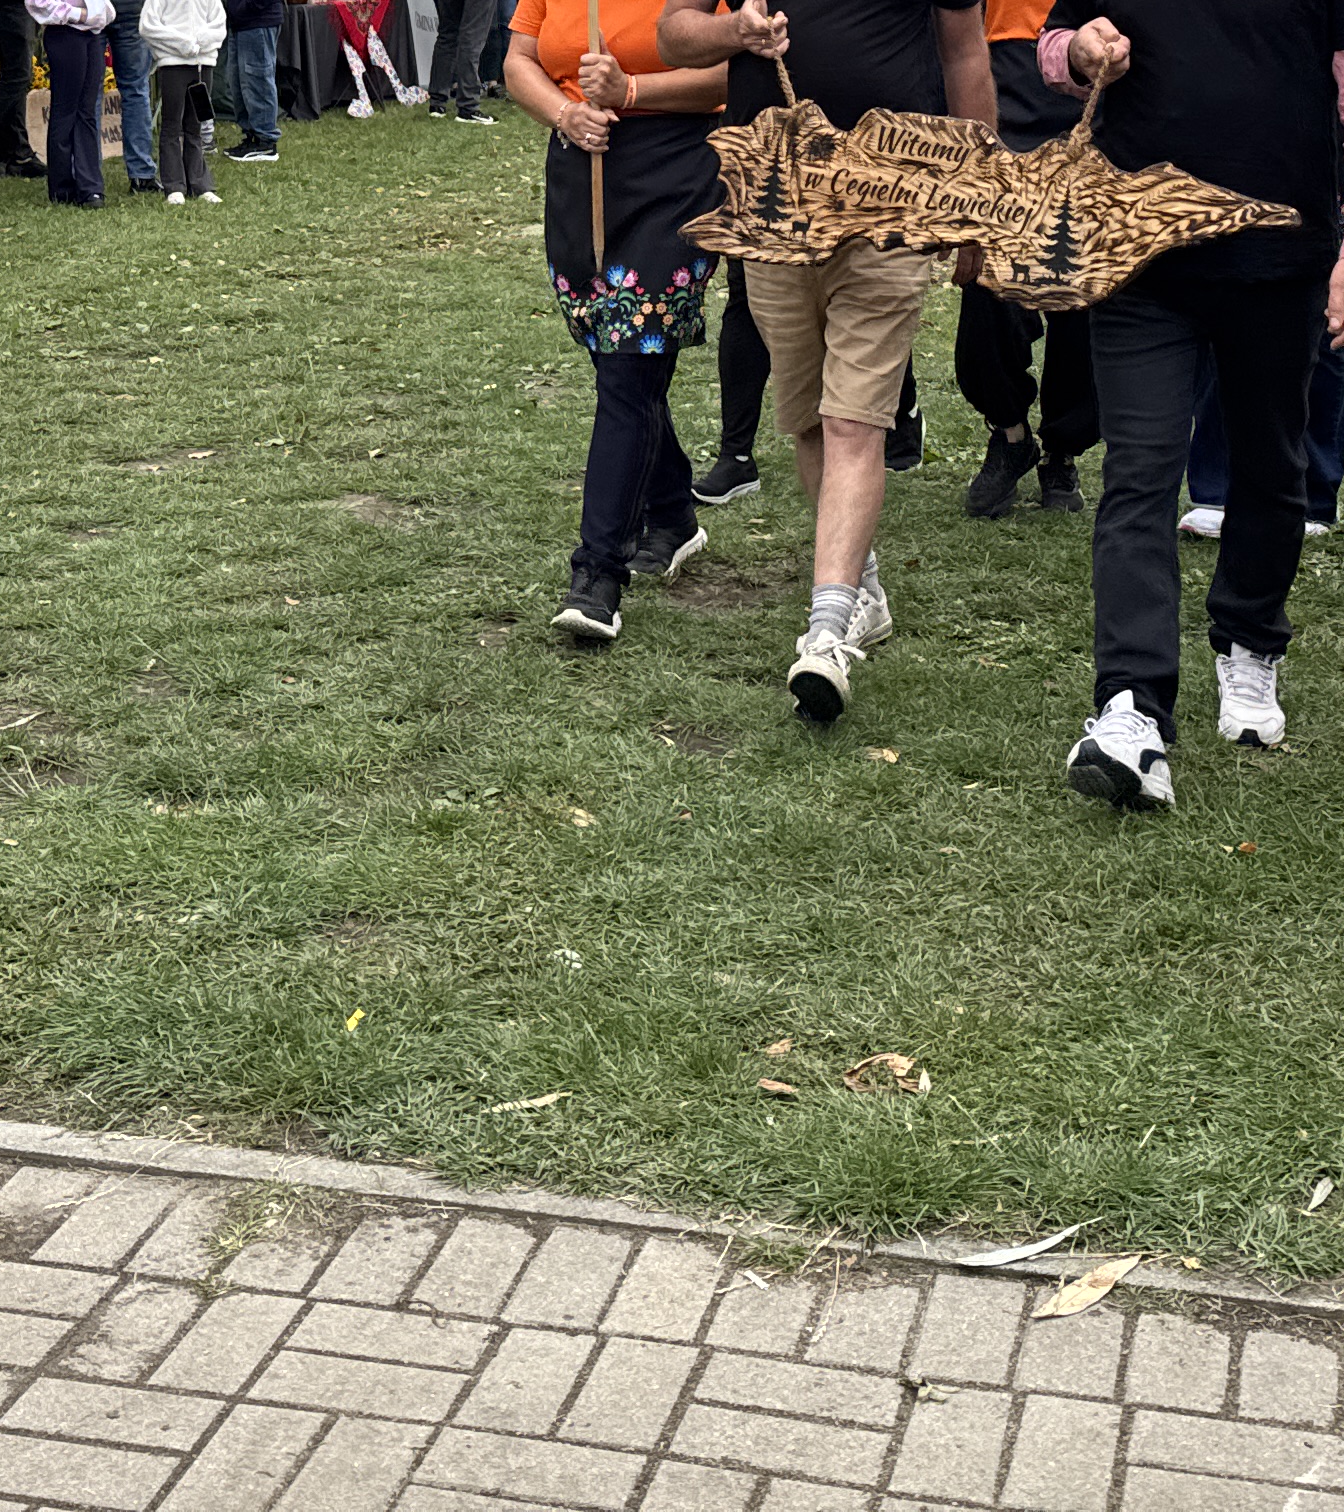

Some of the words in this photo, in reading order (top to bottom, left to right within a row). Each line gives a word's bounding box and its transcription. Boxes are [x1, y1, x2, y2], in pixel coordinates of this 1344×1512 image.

[877, 125, 973, 174] Witamy
[804, 171, 825, 190] w
[830, 168, 920, 206] Cegielni
[924, 184, 1038, 235] Lewickiej
